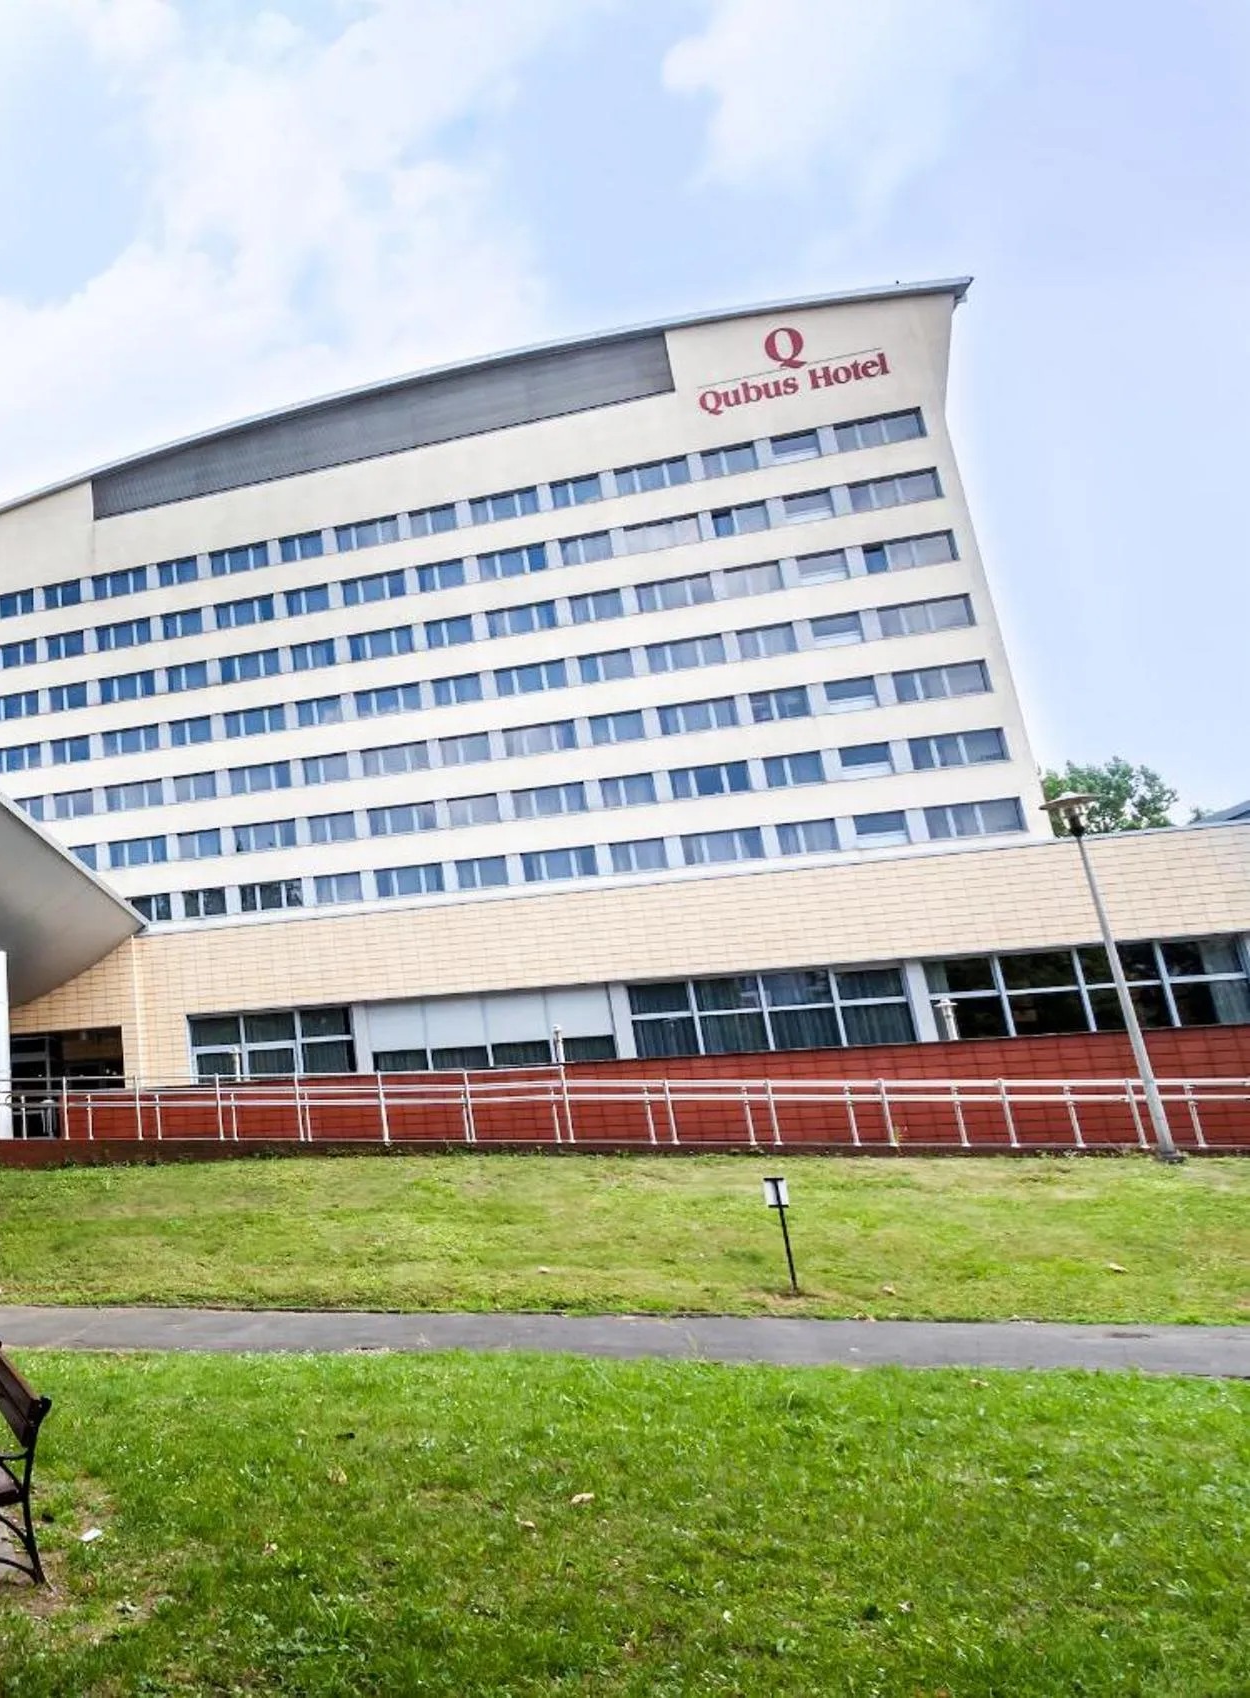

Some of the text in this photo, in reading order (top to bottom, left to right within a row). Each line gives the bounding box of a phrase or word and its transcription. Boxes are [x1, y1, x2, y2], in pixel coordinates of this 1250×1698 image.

[764, 328, 806, 368] Q
[699, 353, 890, 415] Qubus Hotel
